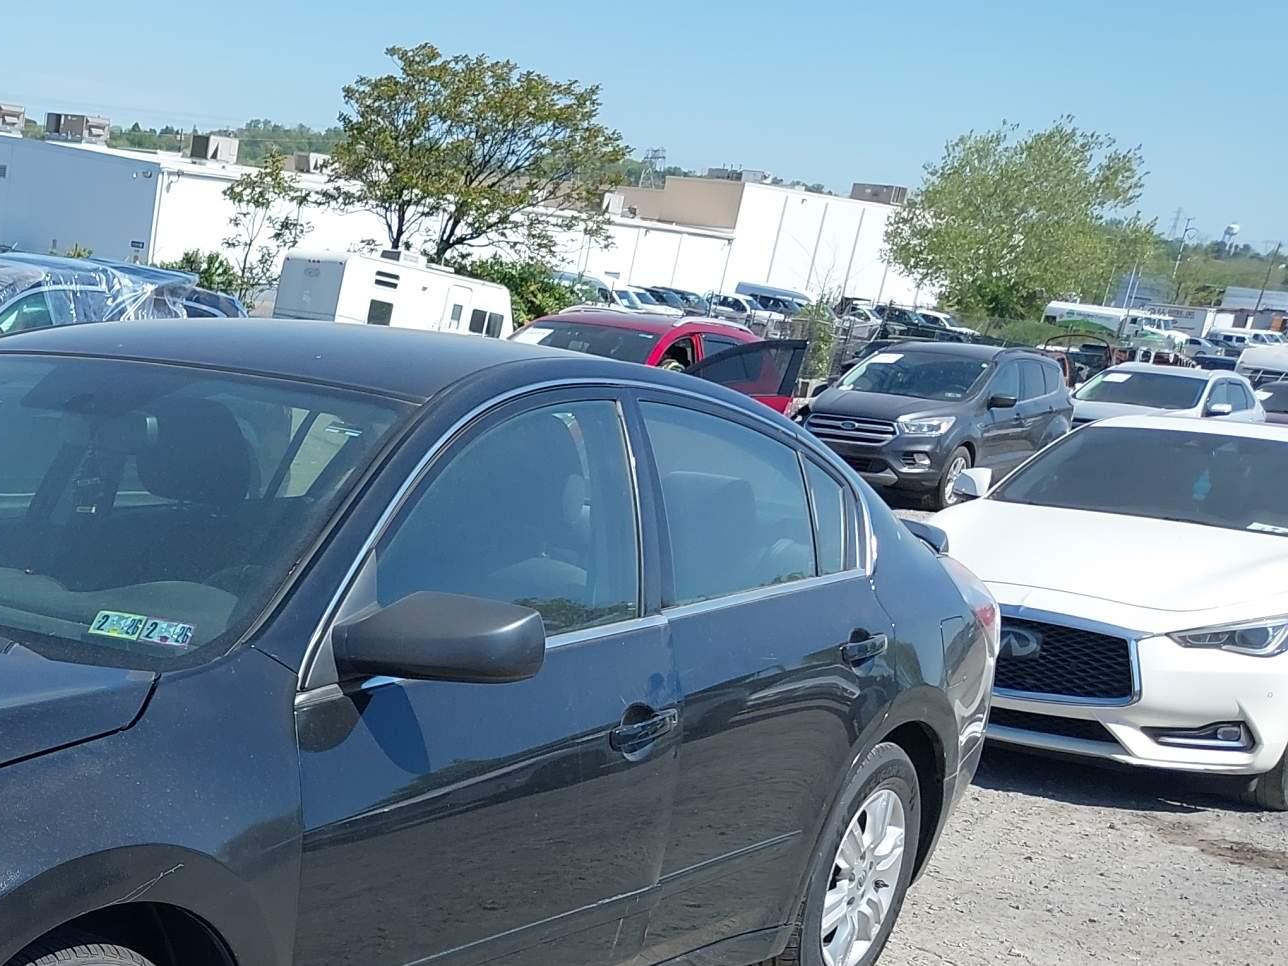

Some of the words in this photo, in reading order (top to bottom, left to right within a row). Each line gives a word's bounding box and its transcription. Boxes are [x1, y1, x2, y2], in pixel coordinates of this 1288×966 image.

[97, 614, 110, 631] 2
[125, 618, 142, 636] 26
[145, 621, 158, 639] 2
